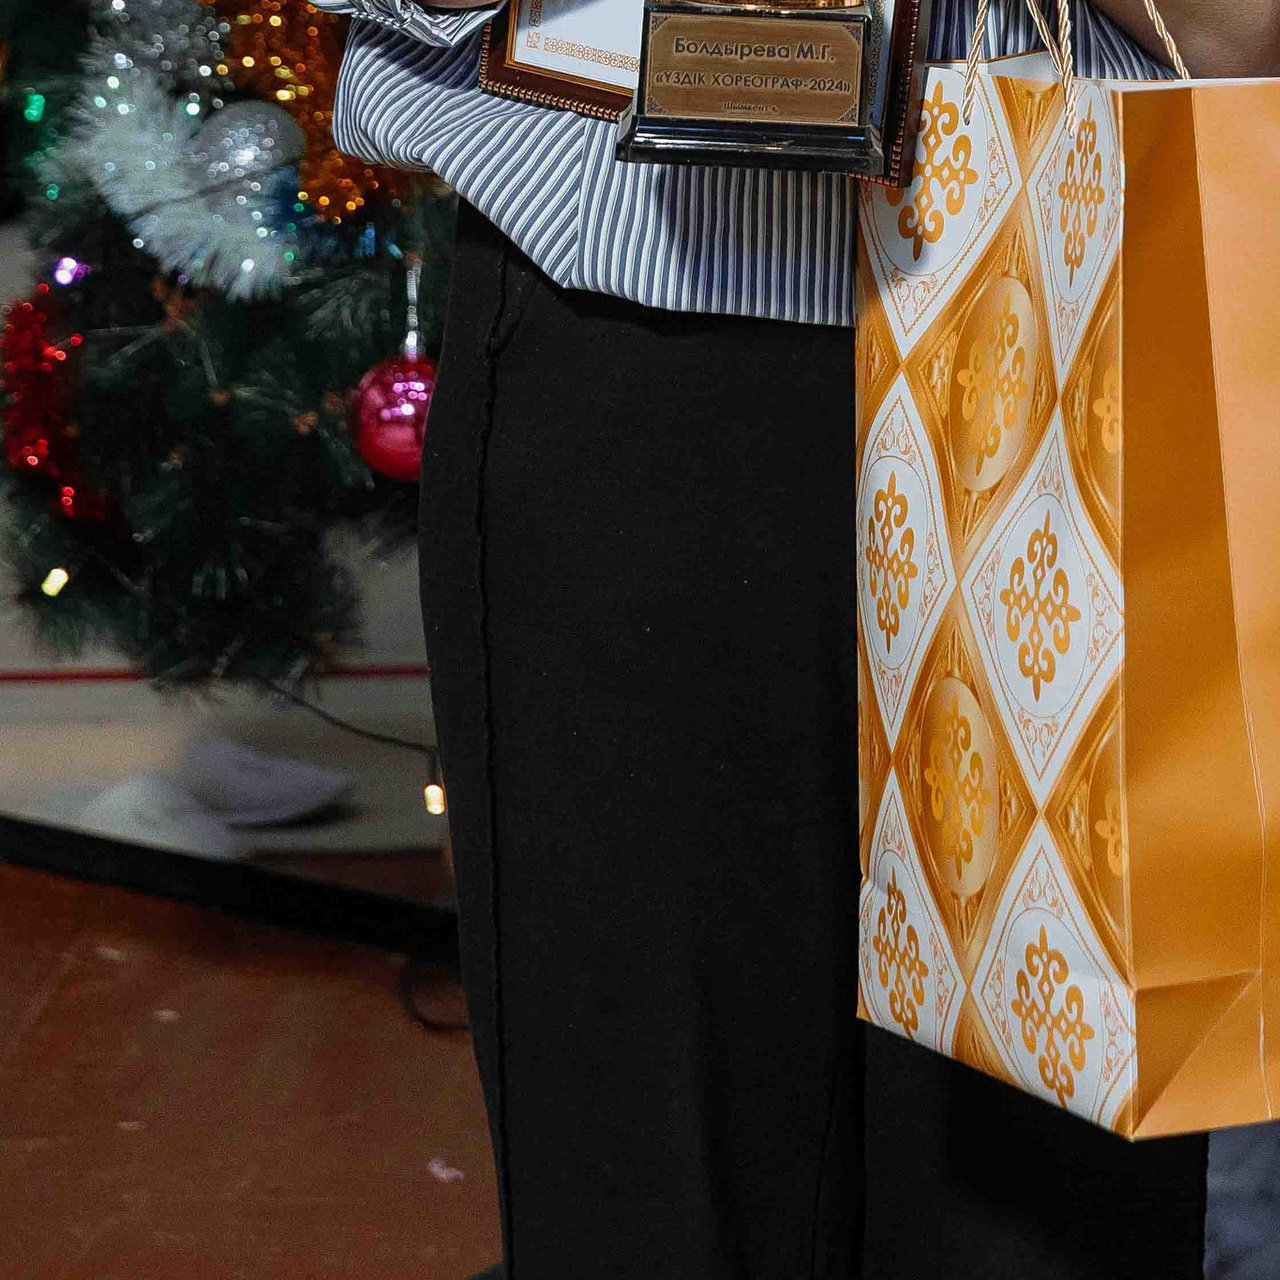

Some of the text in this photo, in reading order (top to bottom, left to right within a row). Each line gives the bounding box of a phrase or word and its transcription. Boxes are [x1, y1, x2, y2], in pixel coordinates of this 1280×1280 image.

[674, 37, 836, 61] Болдырева М.Г.
[711, 73, 851, 92] ХОРЕОГРАФ-2024»
